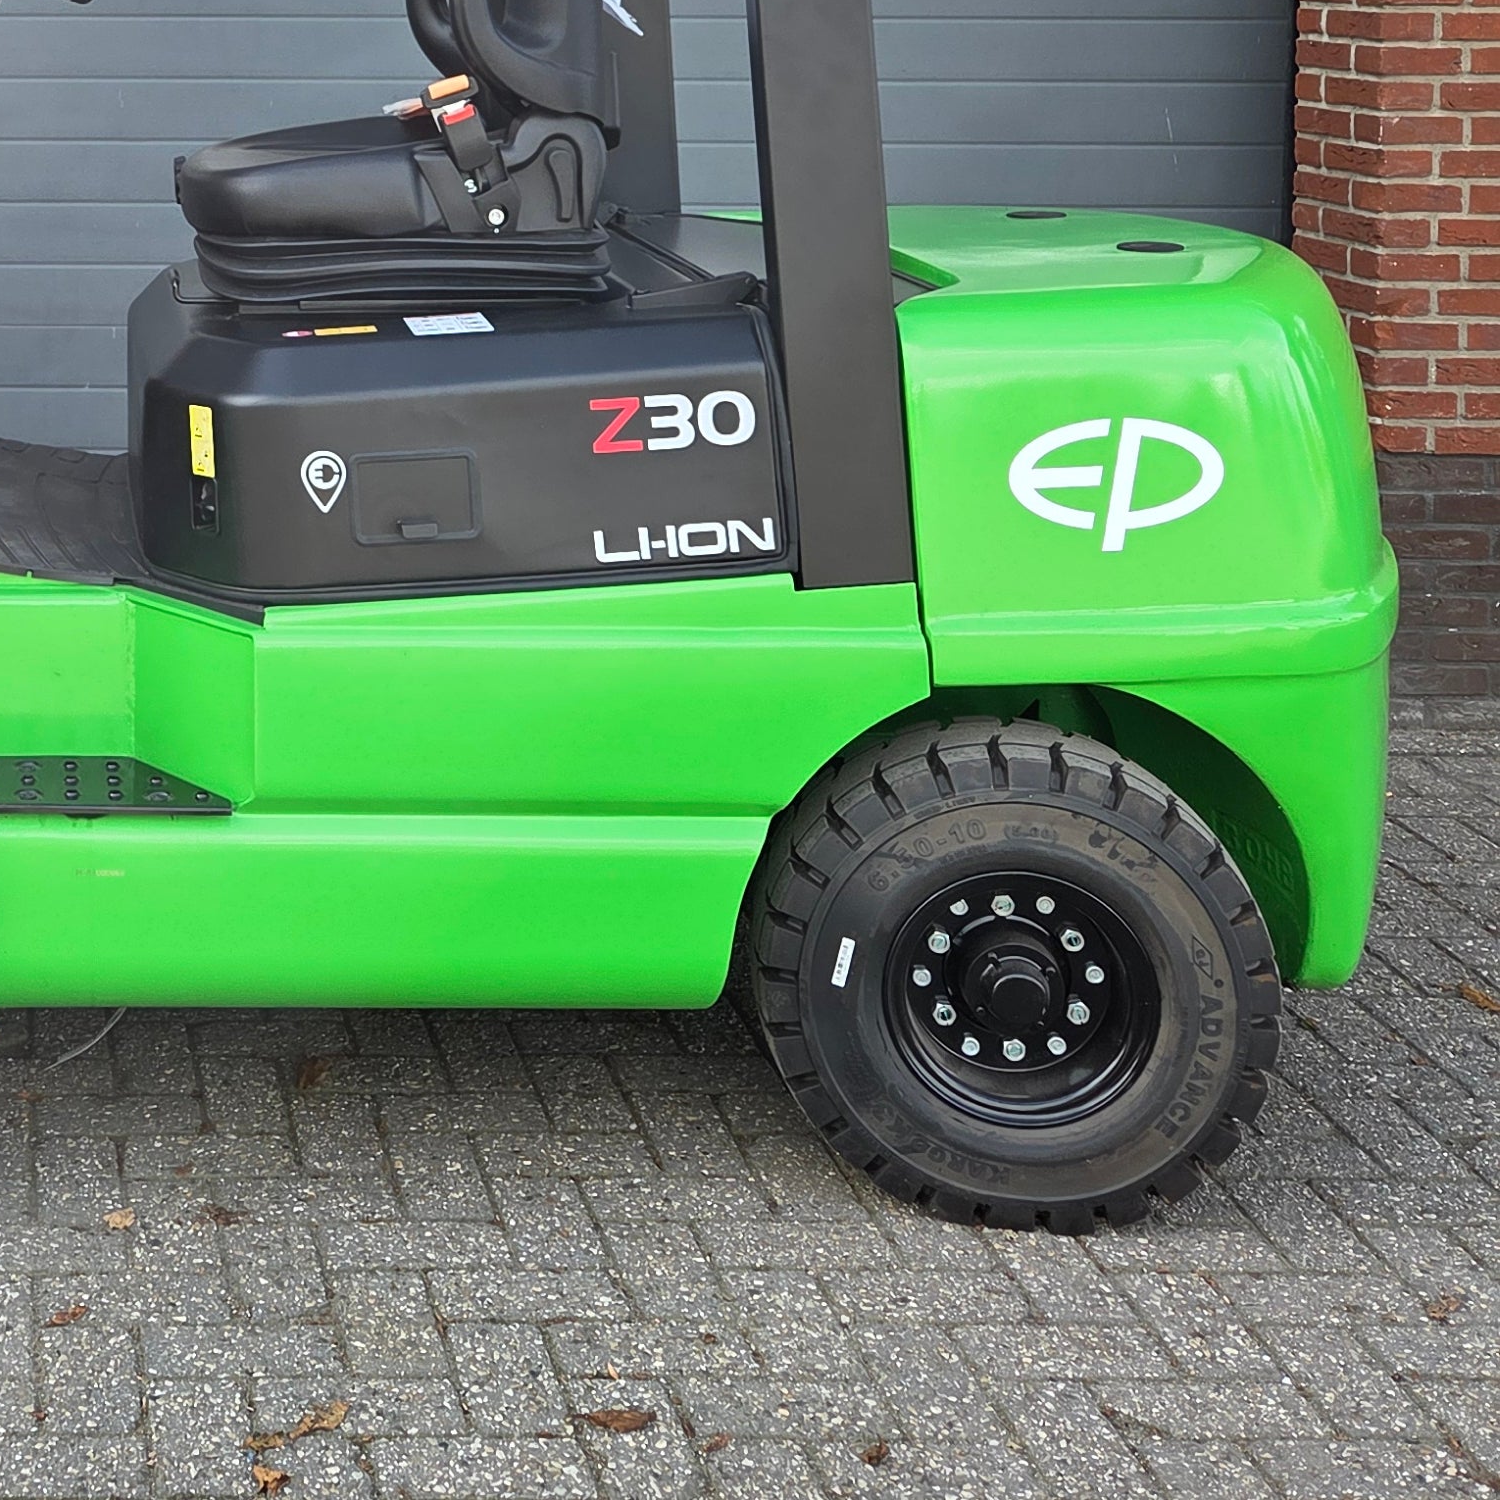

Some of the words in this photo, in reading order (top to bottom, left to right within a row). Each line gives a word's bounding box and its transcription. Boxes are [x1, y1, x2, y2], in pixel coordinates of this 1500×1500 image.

[589, 390, 756, 454] Z30
[1008, 417, 1225, 552] EP
[1154, 994, 1224, 1141] ADVANCE
